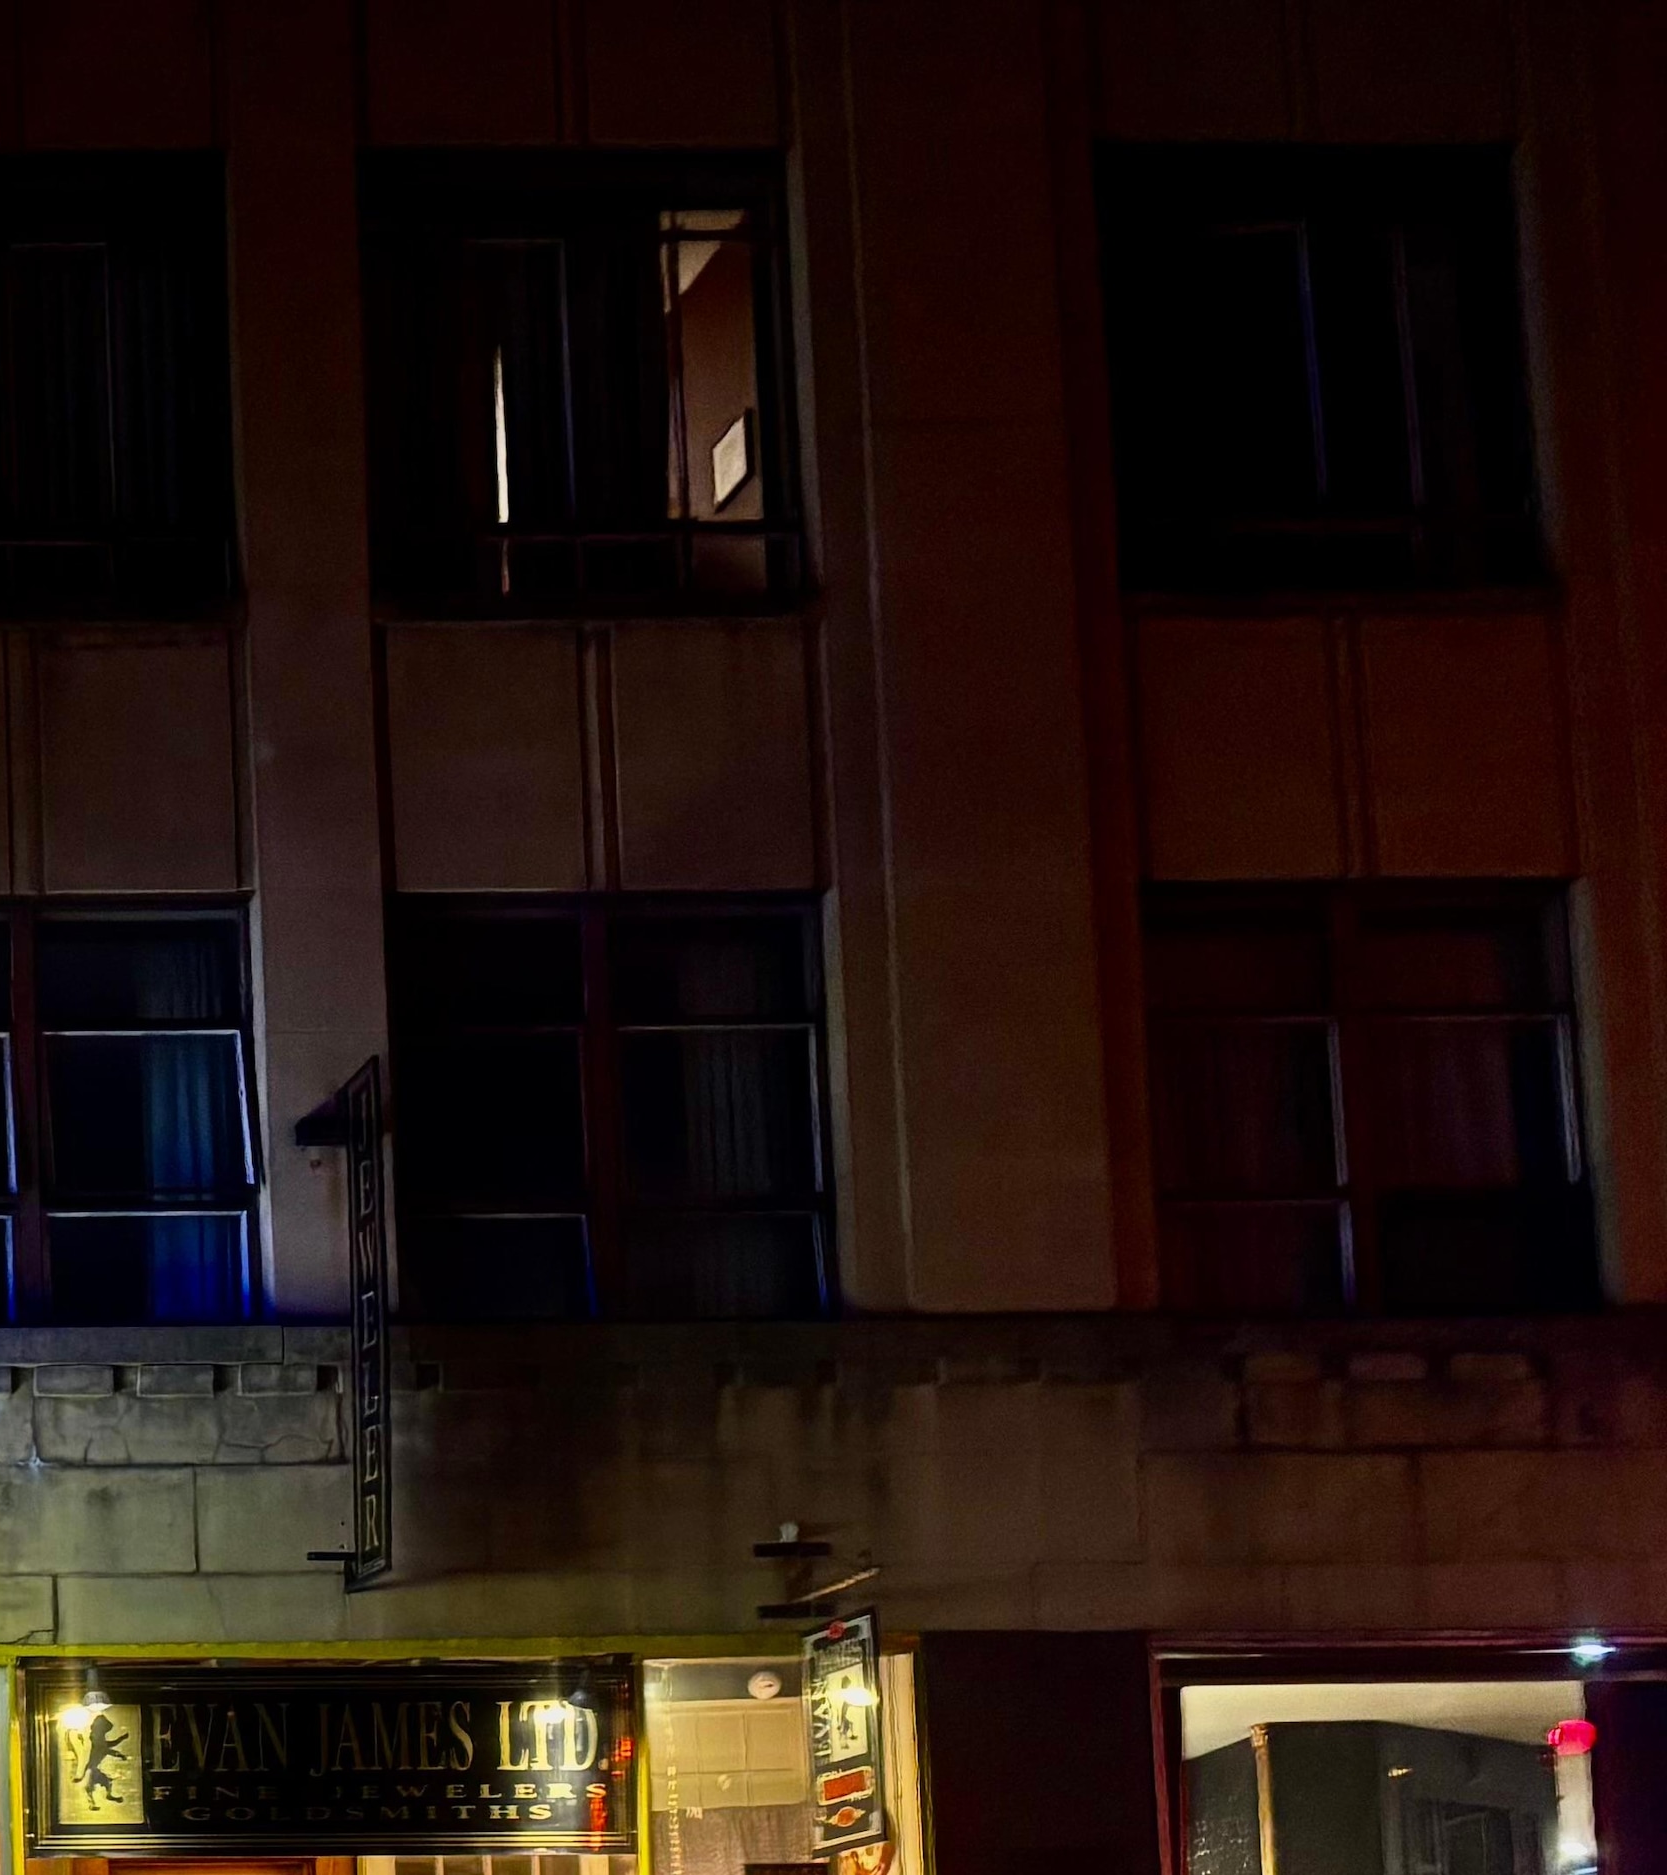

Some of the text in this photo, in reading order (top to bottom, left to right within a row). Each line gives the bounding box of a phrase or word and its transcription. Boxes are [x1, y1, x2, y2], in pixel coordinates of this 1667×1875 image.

[355, 1084, 382, 1553] JEWELER
[149, 1699, 608, 1778] EVAN JAMES LTD.
[152, 1782, 608, 1801] FINE JEWELERS
[181, 1804, 554, 1822] GOLDSMITHS
